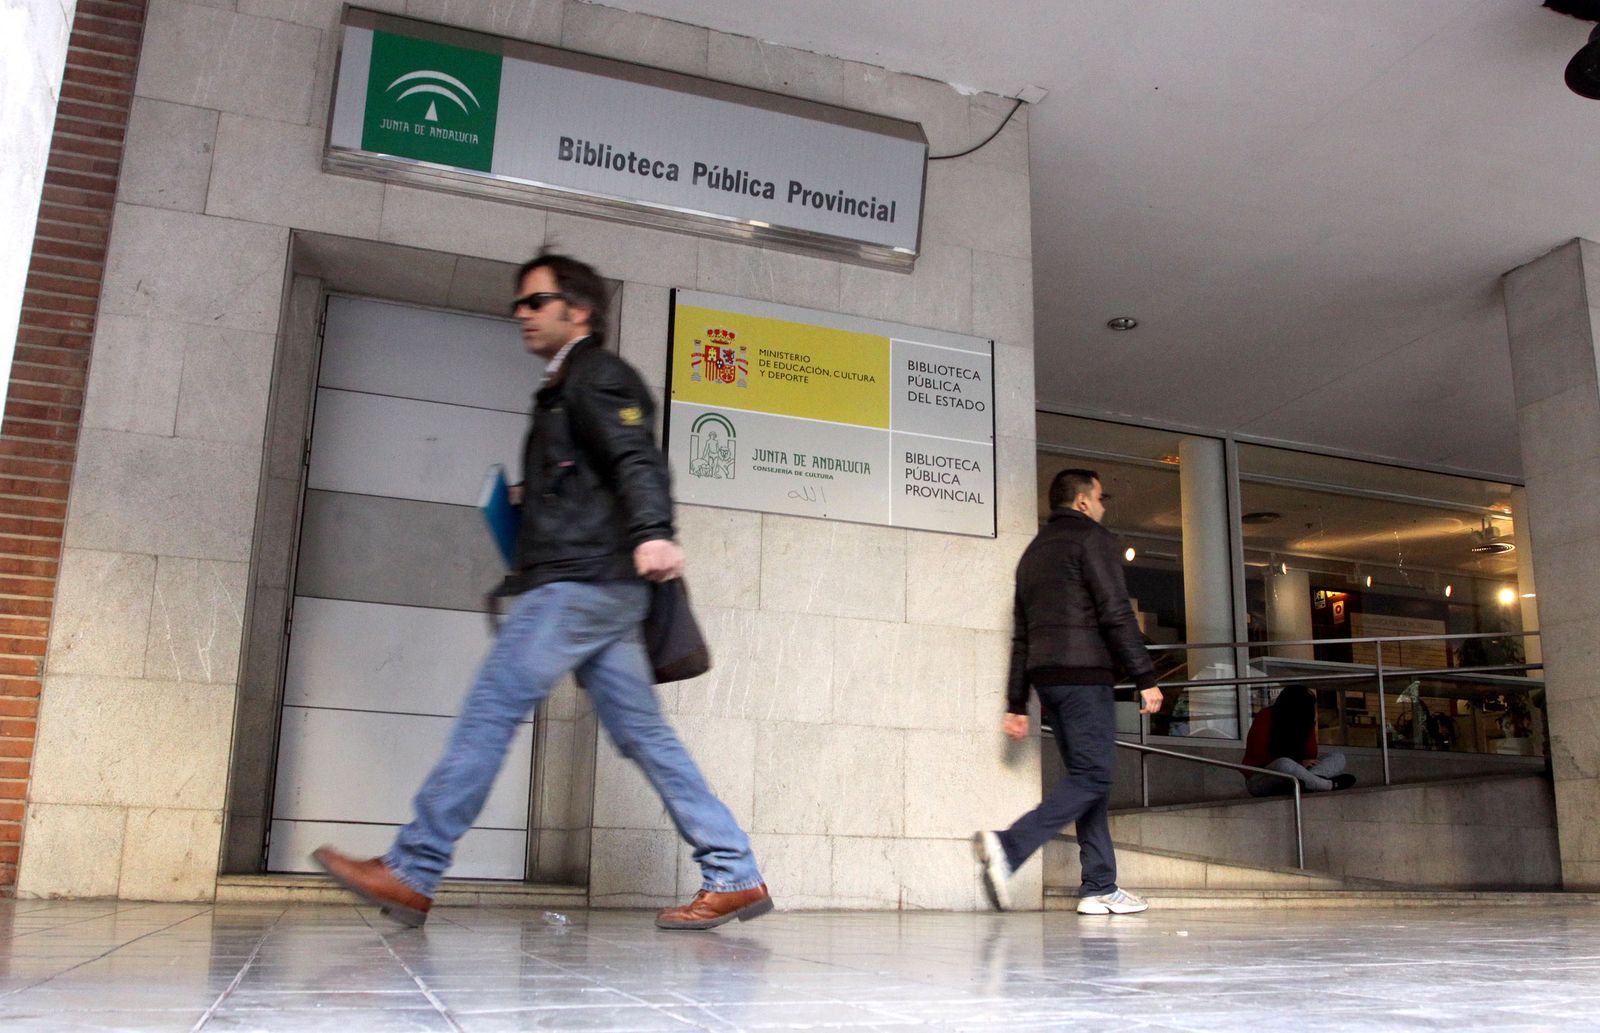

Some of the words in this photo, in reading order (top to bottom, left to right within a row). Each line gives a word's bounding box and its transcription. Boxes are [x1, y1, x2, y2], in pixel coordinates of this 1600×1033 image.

[380, 118, 409, 132] JUNTA
[414, 124, 425, 135] DE
[558, 136, 679, 181] Biblioteca
[692, 161, 775, 200] Pública
[787, 180, 896, 223] Provincial
[759, 348, 811, 363] MINISTERIO
[758, 359, 771, 368] DE
[773, 361, 832, 377] EDUCACIÓN,
[833, 370, 876, 383] CULTURA
[768, 371, 809, 384] DEPORTE
[907, 359, 981, 382] BIBLIOTECA
[907, 374, 962, 393] PÚBLICA
[907, 390, 932, 404] DEL
[935, 395, 986, 412] ESTADO
[752, 448, 788, 464] JUNTA
[793, 453, 807, 467] DE
[905, 452, 981, 473] BIBLIOTECA
[752, 465, 793, 475] CONSEJERÍA
[804, 471, 834, 480] CULTURA
[905, 466, 961, 486] PÚBLICA
[905, 483, 985, 505] PROVINCIAL
